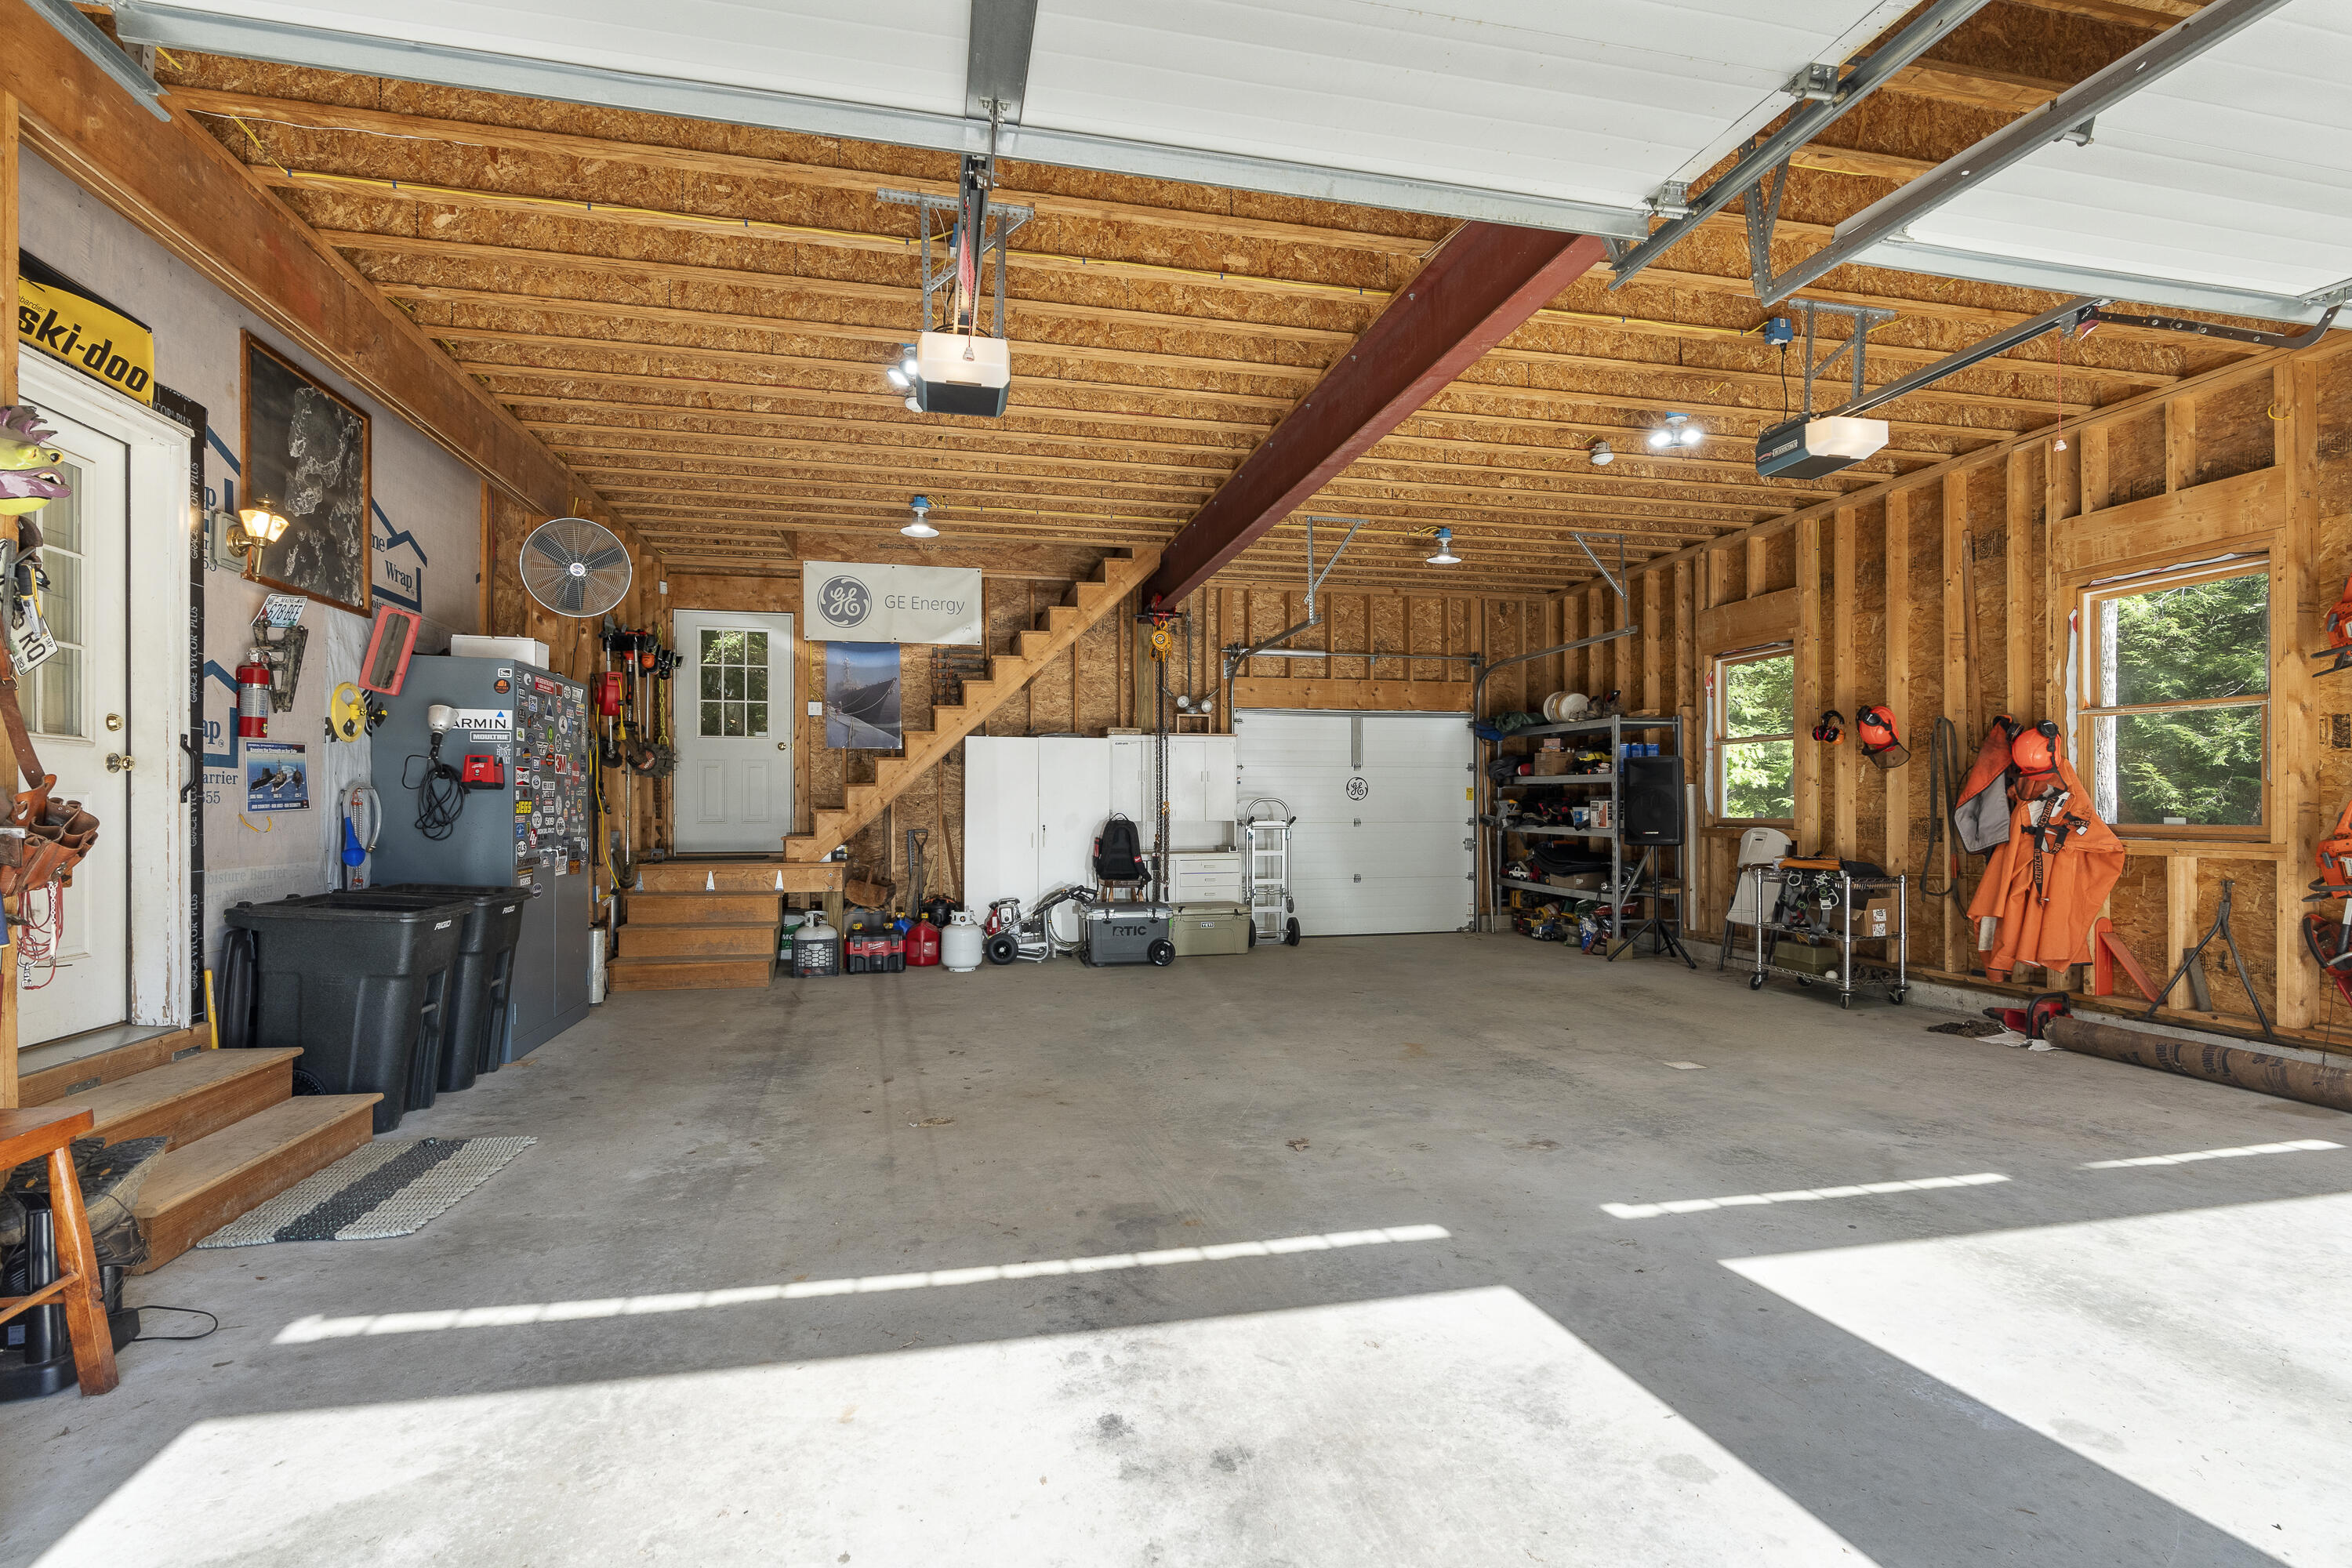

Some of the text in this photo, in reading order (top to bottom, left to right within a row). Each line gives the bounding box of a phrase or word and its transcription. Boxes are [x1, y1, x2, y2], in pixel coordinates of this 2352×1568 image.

[19, 295, 46, 314] bardier
[19, 305, 149, 393] ski-doo
[372, 533, 386, 553] me
[385, 560, 412, 593] Wrap
[884, 594, 965, 615] GE Energy
[454, 718, 506, 729] ARMIN
[495, 747, 511, 756] HUNT
[556, 755, 567, 774] 3M
[203, 771, 238, 785] arrier
[203, 790, 220, 804] 55
[516, 800, 532, 814] JEGS
[206, 871, 246, 885] oisture
[1112, 926, 1147, 936] RTIC
[2201, 1044, 2218, 1074] SONOTU
